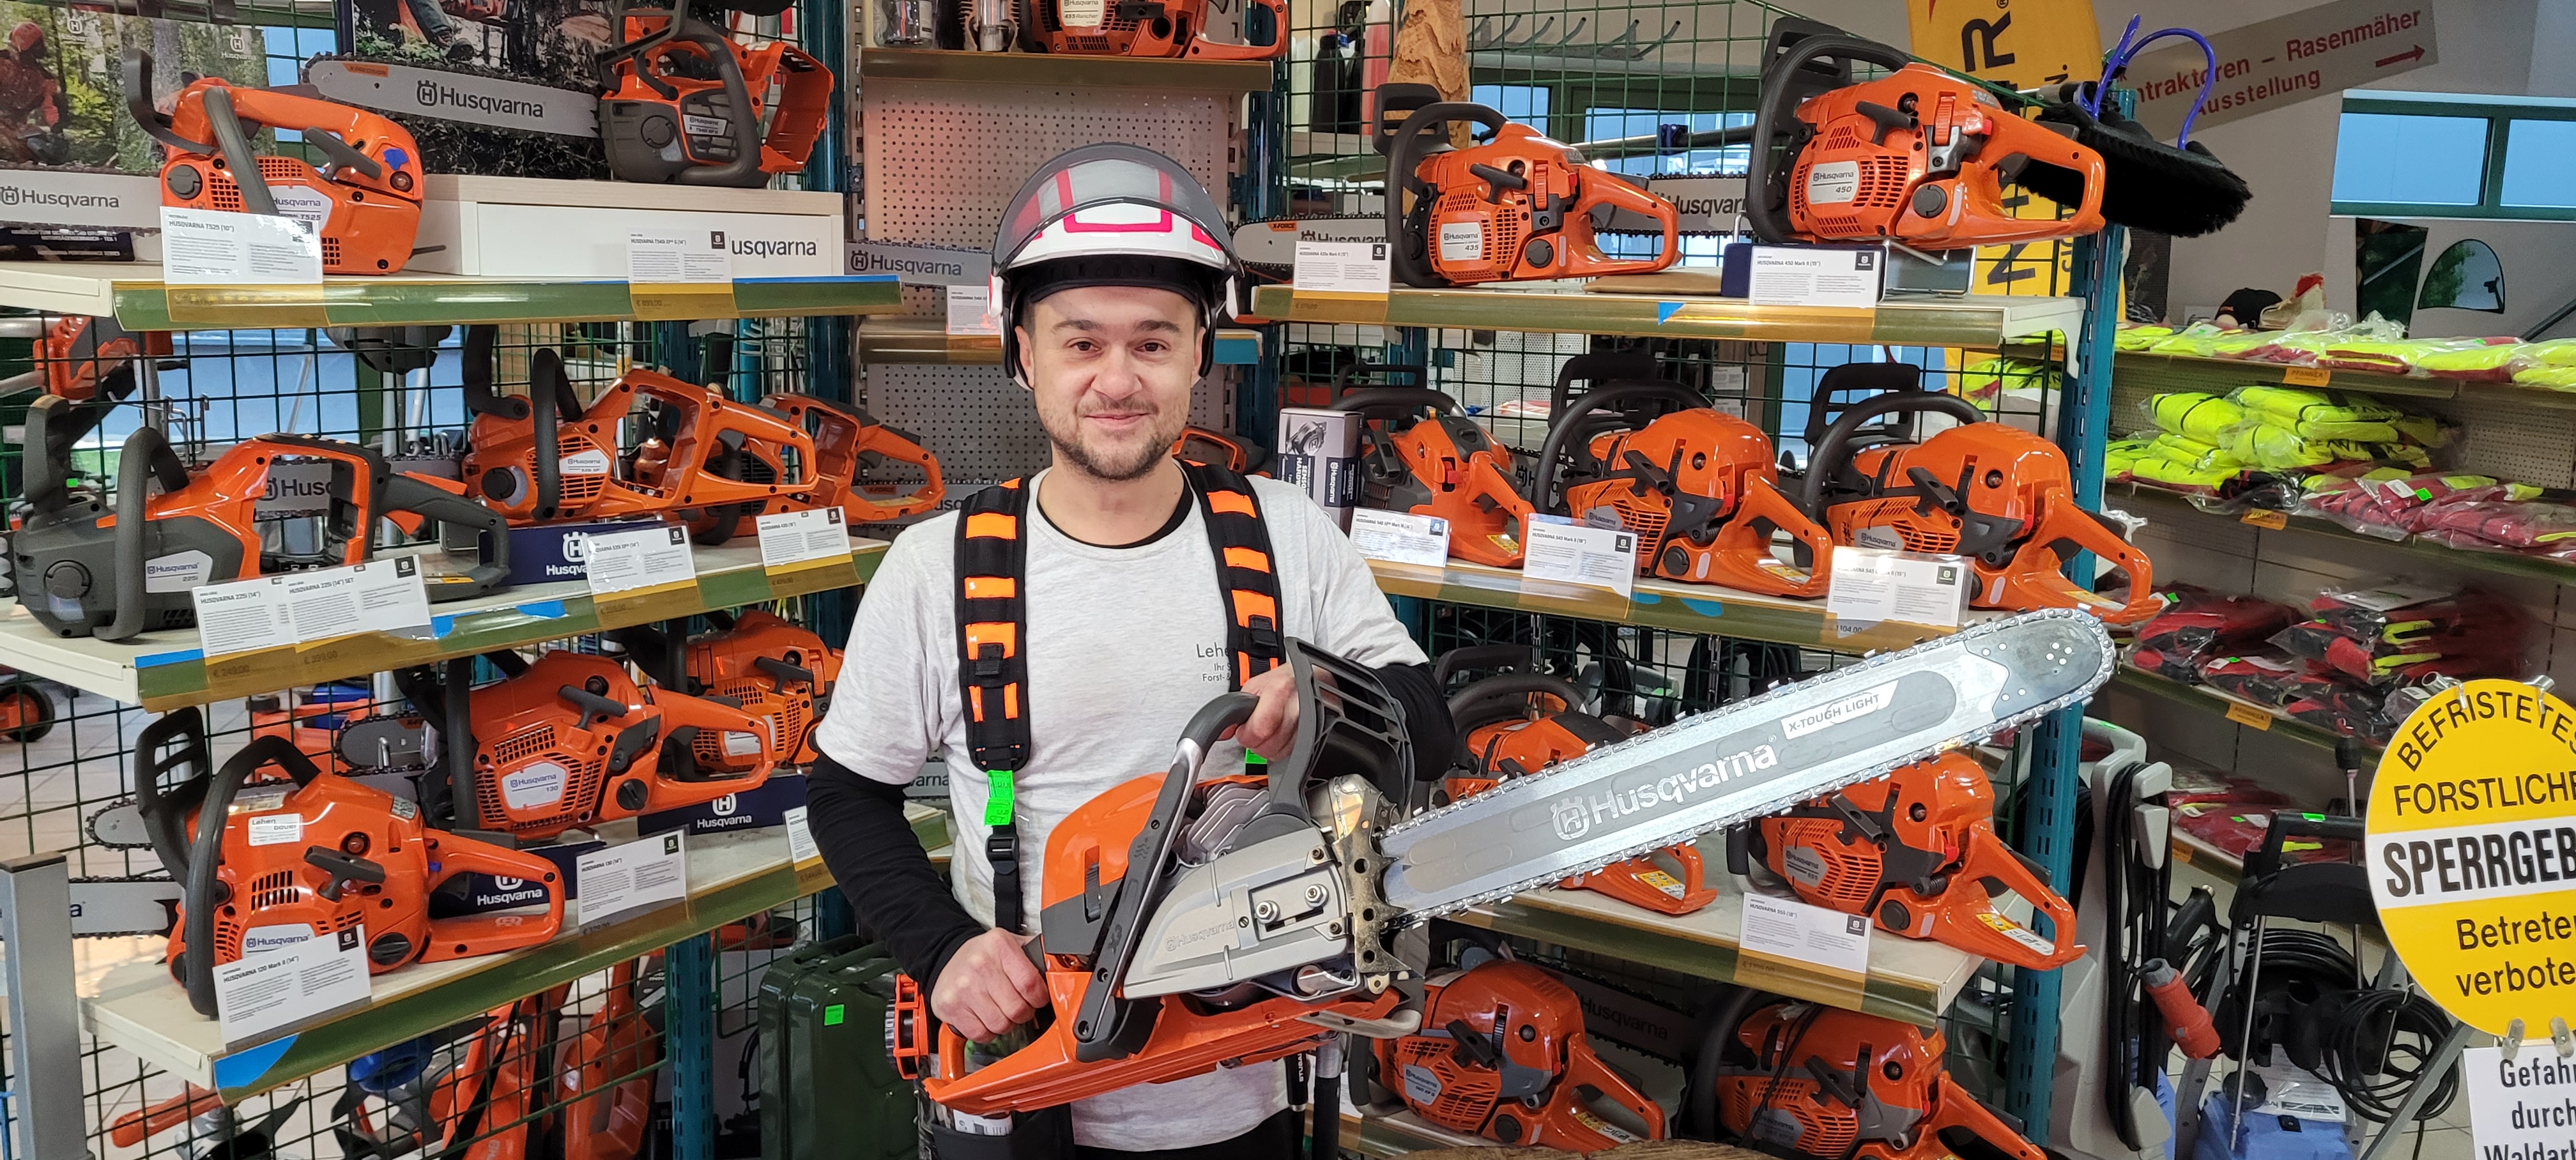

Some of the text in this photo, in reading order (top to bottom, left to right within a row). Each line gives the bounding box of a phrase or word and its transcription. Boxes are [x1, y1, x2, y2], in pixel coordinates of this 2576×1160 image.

[2285, 9, 2421, 62] Rasenmäher
[440, 86, 544, 118] Husqvarna
[1820, 172, 1854, 180] Husqvarna
[22, 189, 120, 209] Husqvarna
[169, 220, 205, 230] HUSQVARNA
[205, 222, 220, 231] T525
[1450, 233, 1480, 241] Husqvarna
[729, 235, 816, 259] usqvarna
[871, 254, 962, 276] Husqvarna
[1329, 469, 1338, 503] Husqvarna
[1593, 514, 1616, 526] Husqvarna
[1867, 534, 1896, 547] Husqvarna
[156, 563, 199, 573] Husqvarna
[289, 583, 320, 595] HUSQVARNA
[969, 581, 976, 590] S
[201, 595, 234, 604] HUSQVARNA
[1214, 662, 1225, 671] Ihr
[1202, 673, 1225, 682] Forst-
[1789, 693, 1881, 733] X-TOUGH LIGHT
[518, 773, 557, 786] Husqvarna
[1591, 743, 1779, 826] Husqvarna
[696, 814, 753, 829] Husqvarna
[1790, 854, 1819, 869] Husqvarna
[477, 888, 543, 906] Husqvarna
[1749, 903, 1777, 914] HUSQVARNA
[1177, 920, 1235, 948] Husqvarna
[2455, 911, 2576, 950] Betrete
[257, 935, 309, 946] Husqvarna
[224, 969, 257, 984] HUSQVARNA
[268, 962, 282, 970] Mark
[1580, 995, 1669, 1041] Husqvarna
